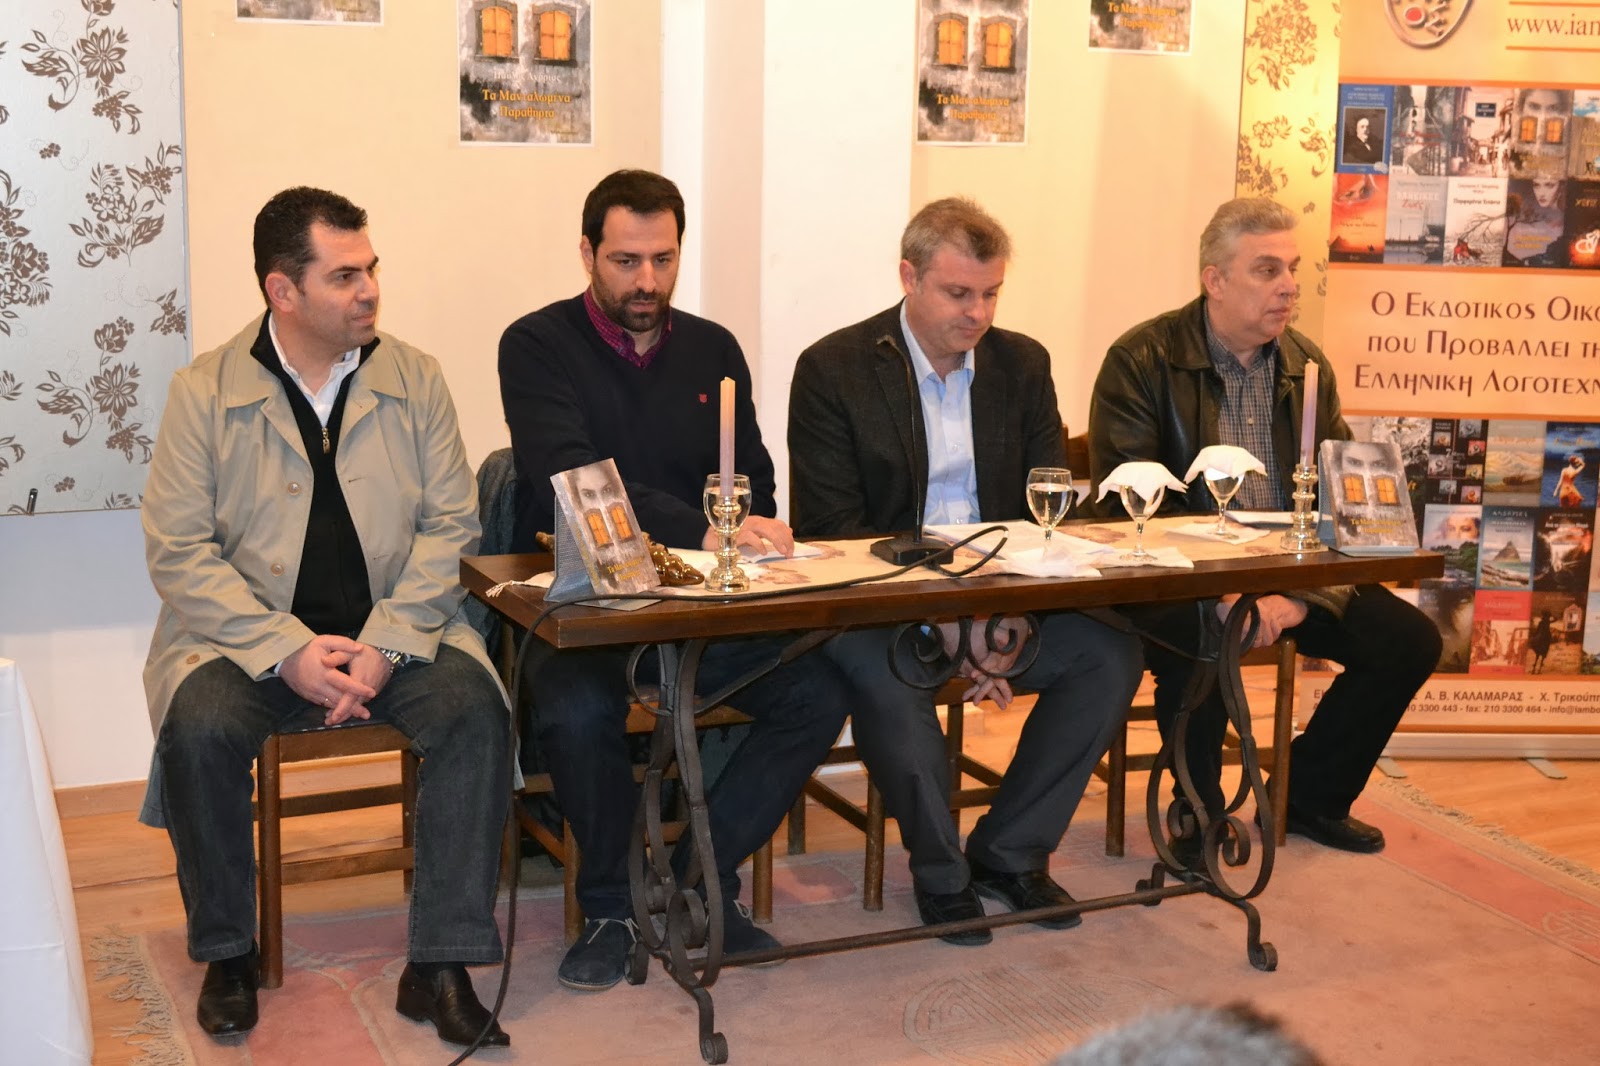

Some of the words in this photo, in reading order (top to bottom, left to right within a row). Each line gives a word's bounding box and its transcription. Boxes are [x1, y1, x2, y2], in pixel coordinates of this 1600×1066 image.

[1371, 291, 1396, 317] Ο
[1418, 704, 1440, 713] 3300
[1442, 704, 1458, 713] 443
[1484, 704, 1500, 714] 210
[1502, 705, 1524, 714] 3300
[1525, 705, 1541, 714] 464
